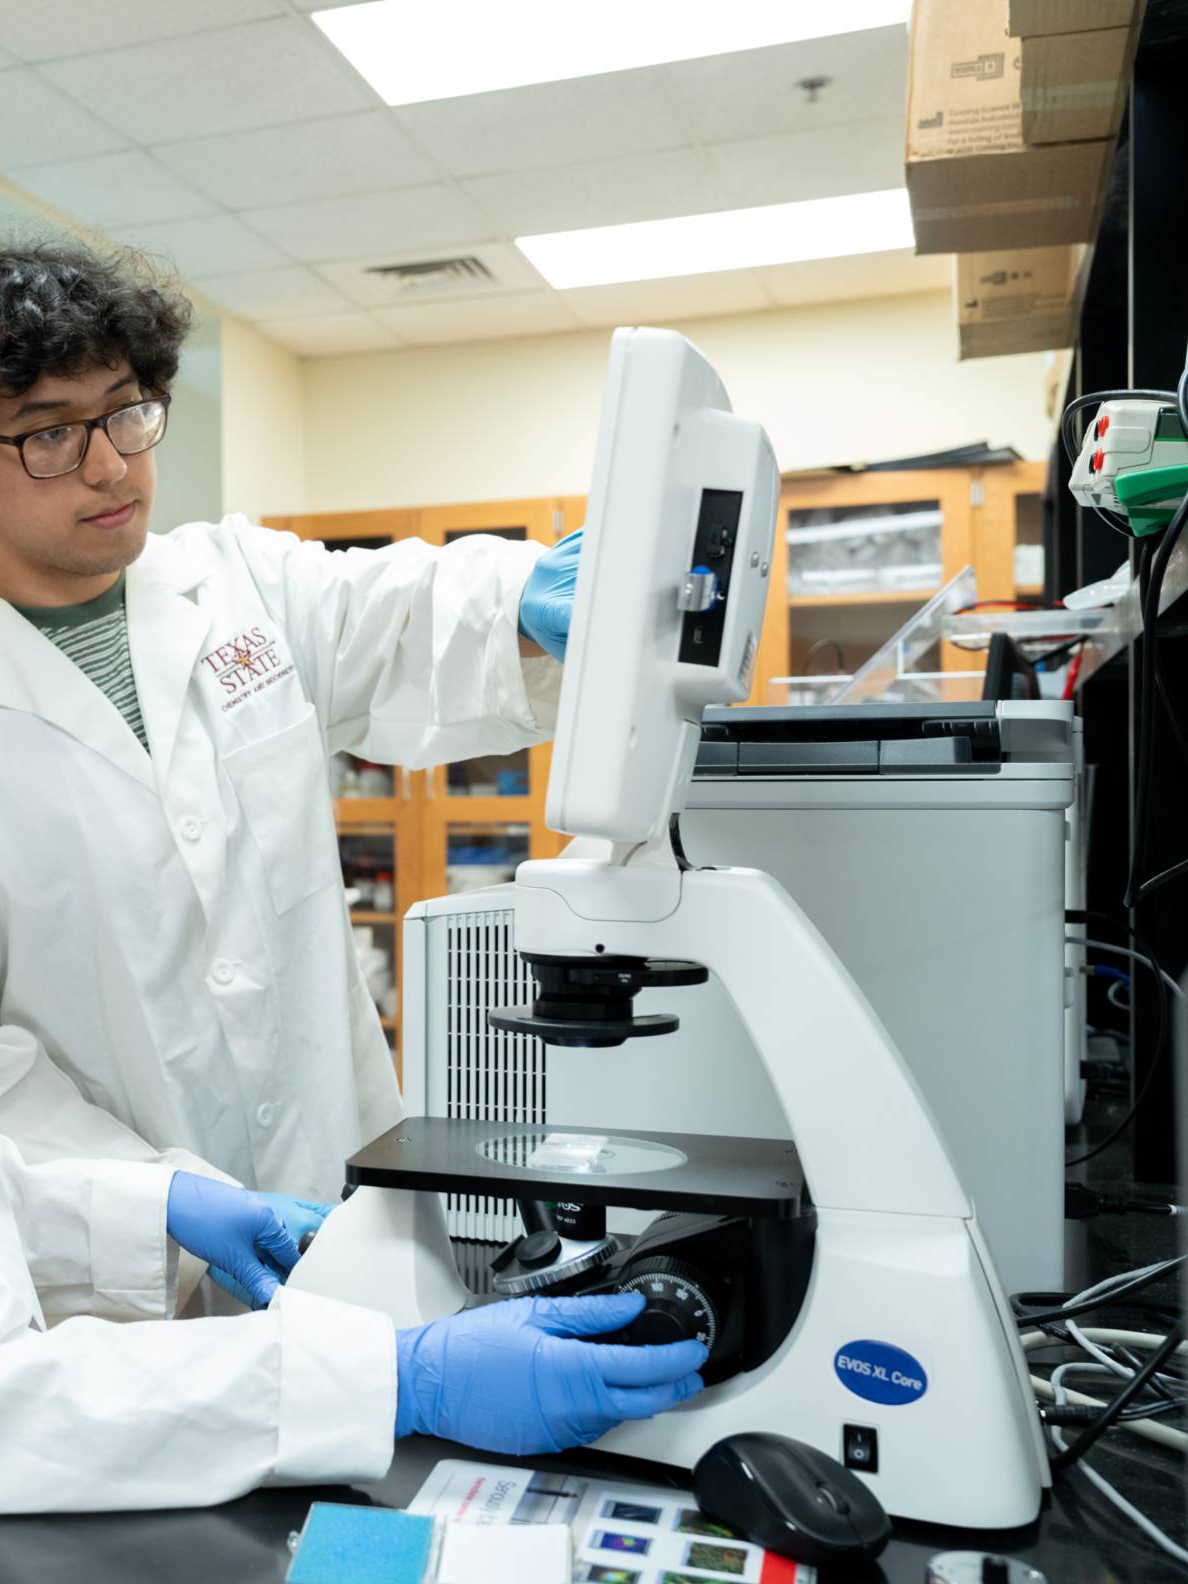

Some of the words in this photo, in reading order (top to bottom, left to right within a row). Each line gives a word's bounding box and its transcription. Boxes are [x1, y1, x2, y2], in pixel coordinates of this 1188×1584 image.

[200, 626, 267, 673] TEXAS
[220, 648, 281, 694] STATE
[837, 1355, 872, 1376] EVOS
[872, 1365, 890, 1381] XL
[891, 1371, 923, 1391] Core
